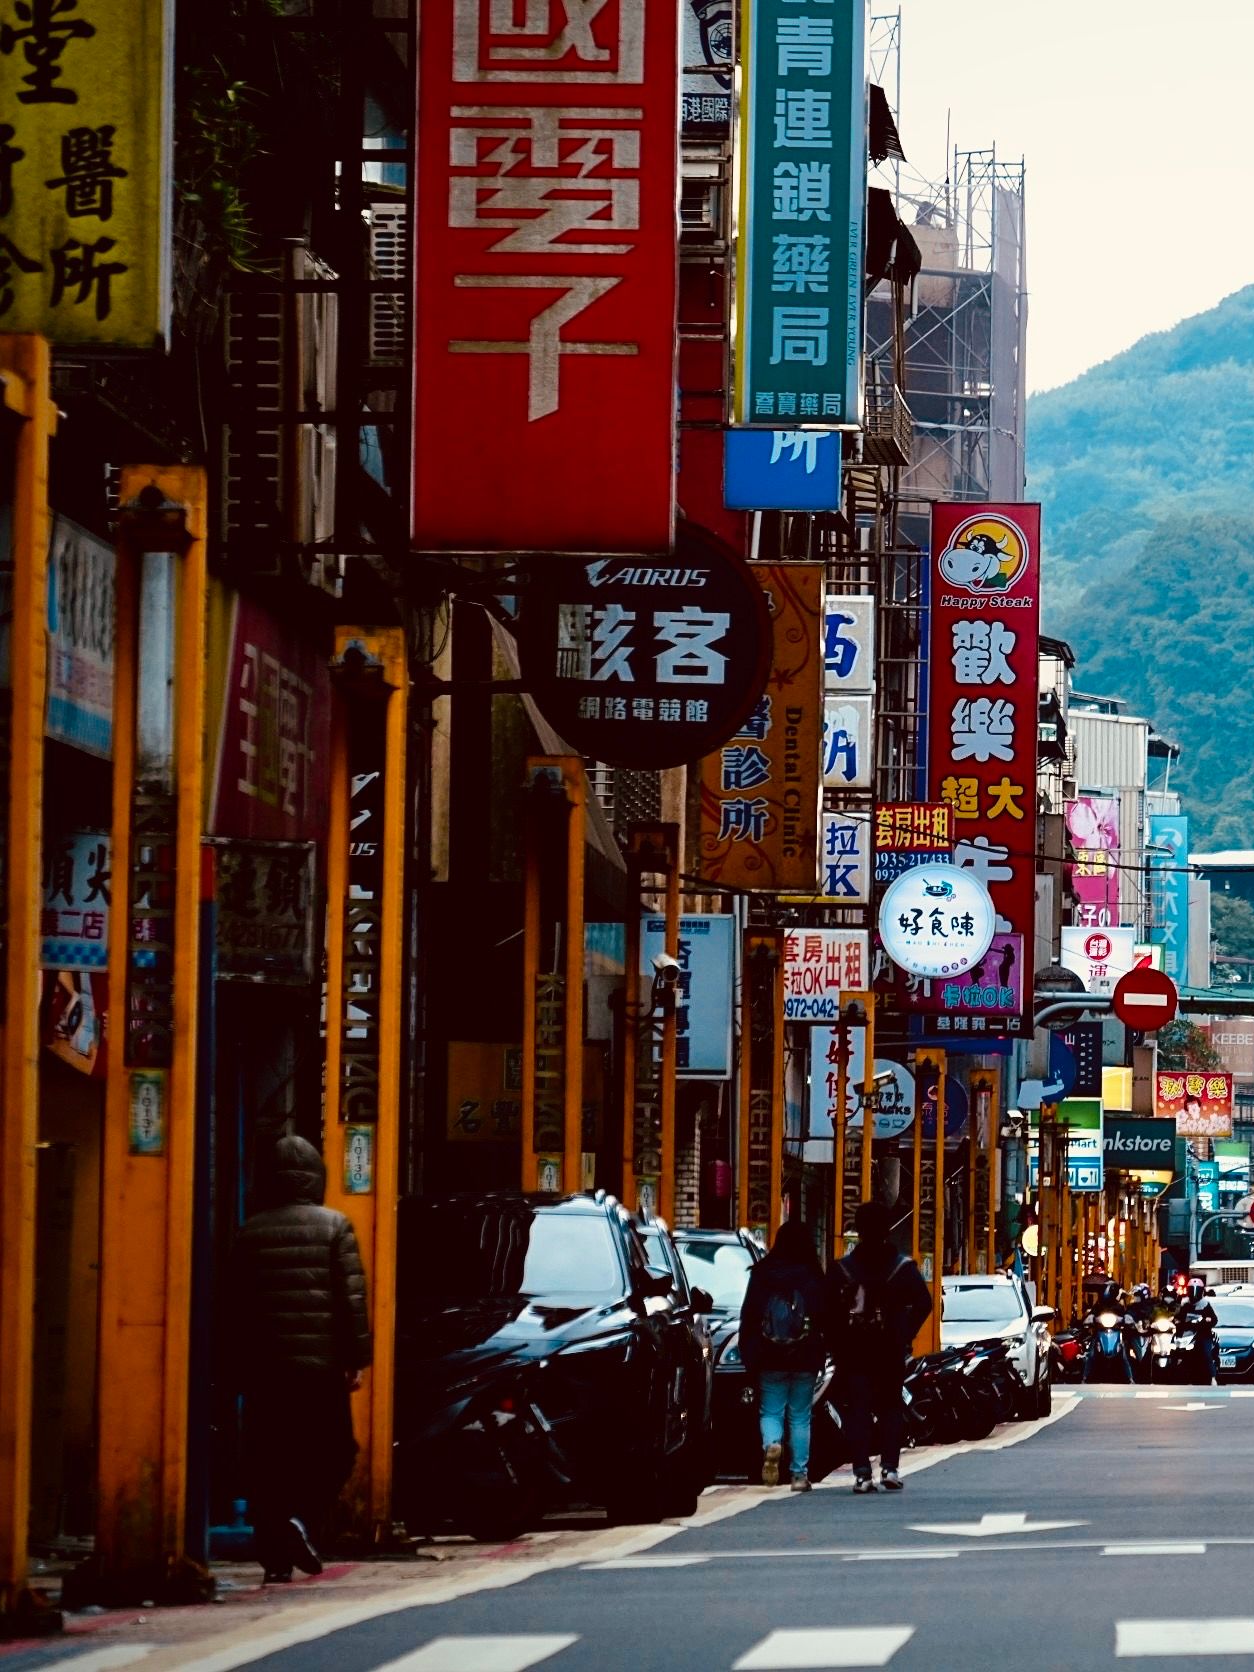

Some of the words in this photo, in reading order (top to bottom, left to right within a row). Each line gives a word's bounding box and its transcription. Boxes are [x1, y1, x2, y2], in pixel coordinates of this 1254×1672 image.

[770, 16, 834, 366] 青連鎖藥局
[606, 567, 711, 587] AORUS
[940, 596, 987, 609] Happy
[989, 596, 1033, 608] Steak
[556, 604, 731, 685] 駭客
[577, 696, 709, 723] 網路電競館
[951, 620, 1017, 762] 歡樂
[783, 705, 803, 783] Dental
[941, 775, 1025, 820] 超大
[782, 786, 801, 859] Clinic
[876, 806, 950, 848] 套房出租
[898, 907, 975, 938] 好食陳
[784, 997, 839, 1019] 972-042-
[943, 983, 1017, 1009] 卡拉OK
